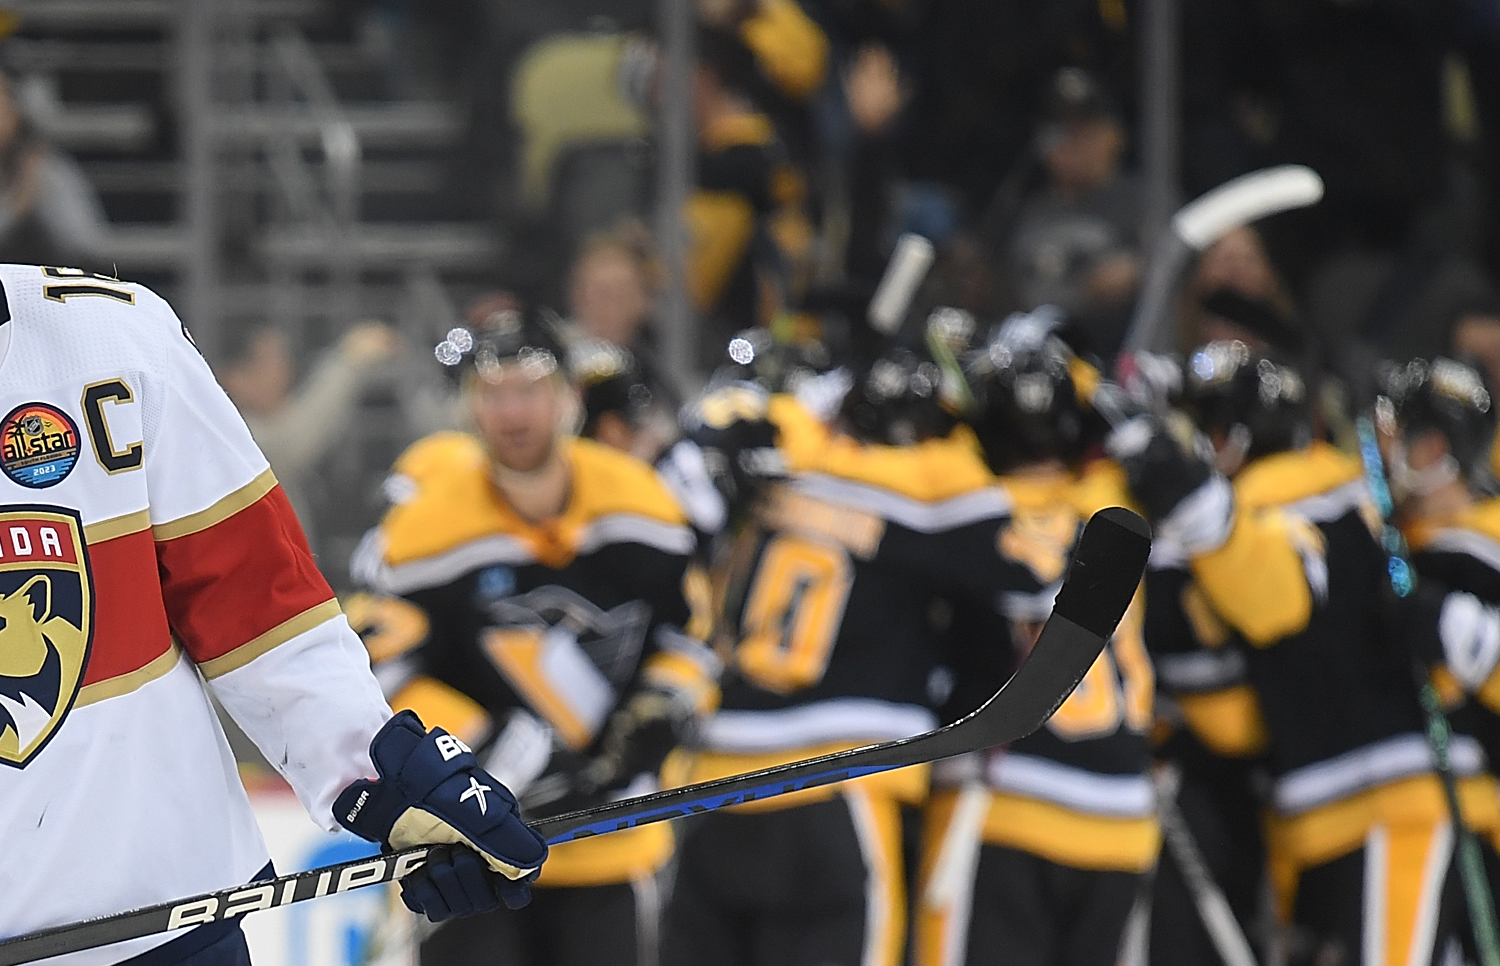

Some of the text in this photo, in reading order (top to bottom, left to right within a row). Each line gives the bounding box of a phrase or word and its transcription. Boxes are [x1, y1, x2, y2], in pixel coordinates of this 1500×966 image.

[81, 378, 143, 475] C
[33, 466, 56, 477] 2023
[347, 790, 370, 823] BAUER
